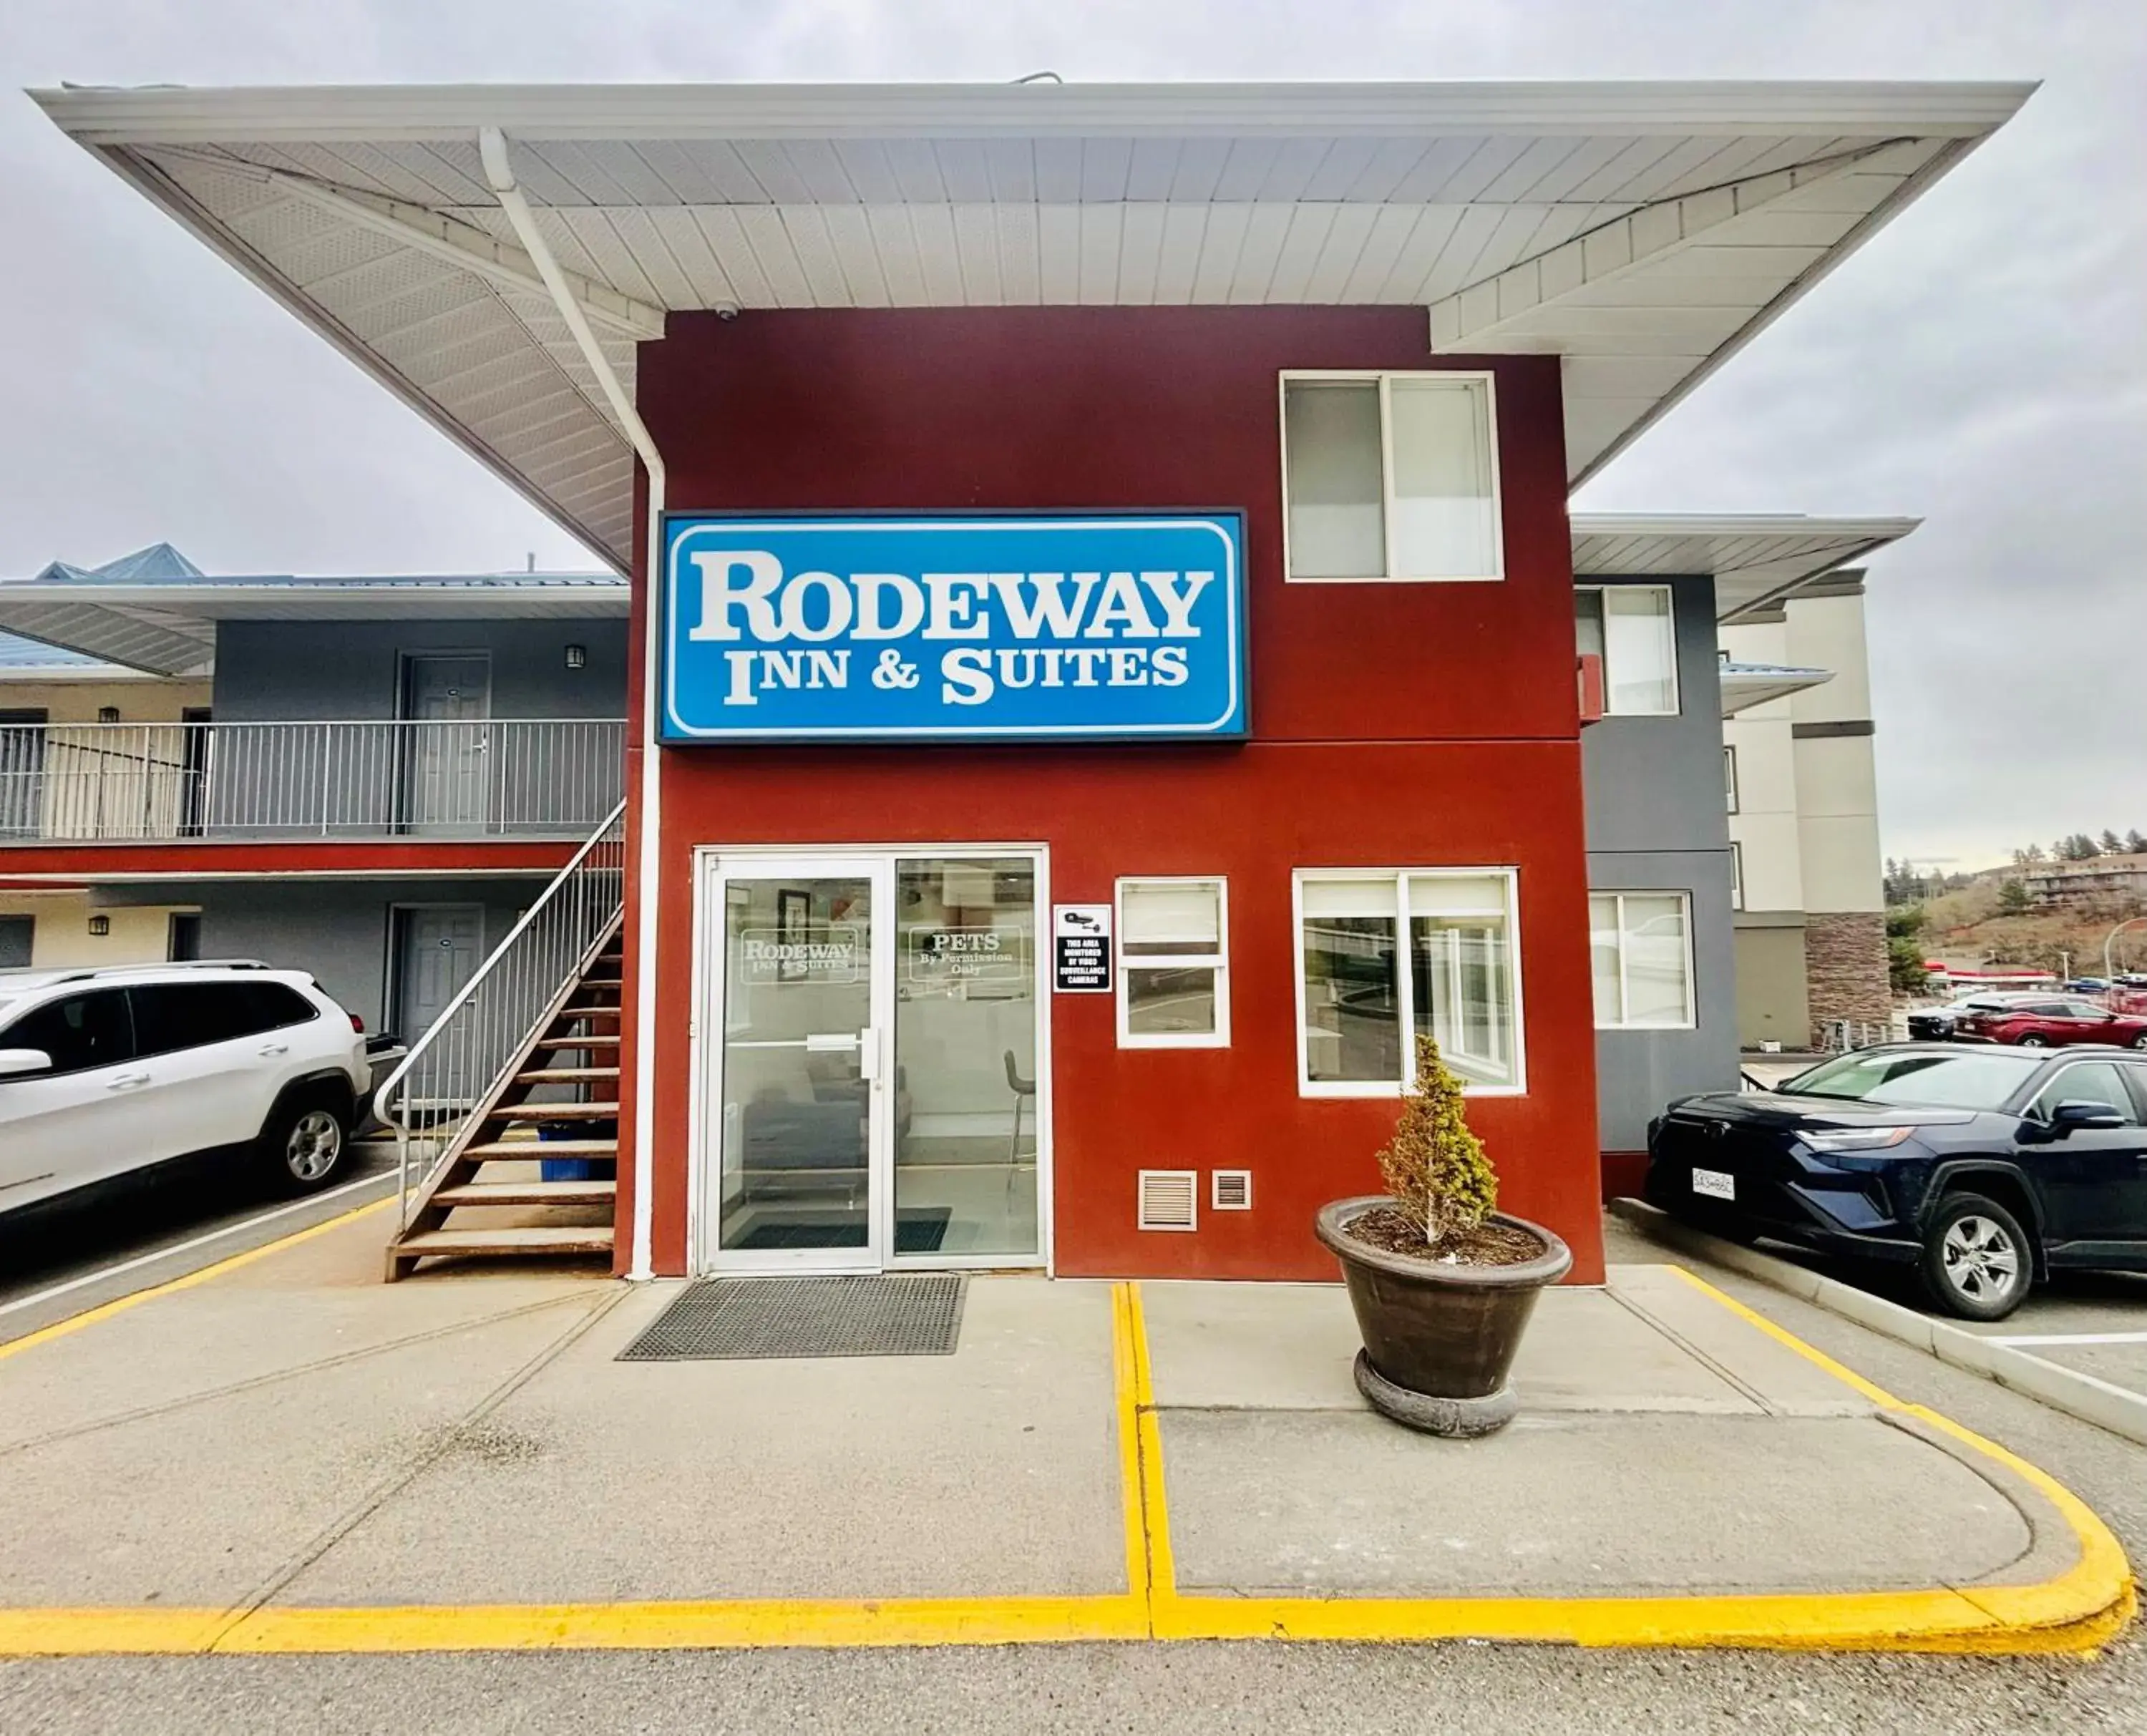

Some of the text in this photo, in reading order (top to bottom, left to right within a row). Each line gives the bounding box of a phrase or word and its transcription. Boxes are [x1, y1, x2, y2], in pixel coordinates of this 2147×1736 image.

[688, 550, 1214, 643] RODEWAY
[724, 646, 1189, 706] INN & SUITES
[745, 940, 854, 960] RODEWAY
[932, 933, 1000, 951] PETS
[920, 952, 1013, 965] By Permission
